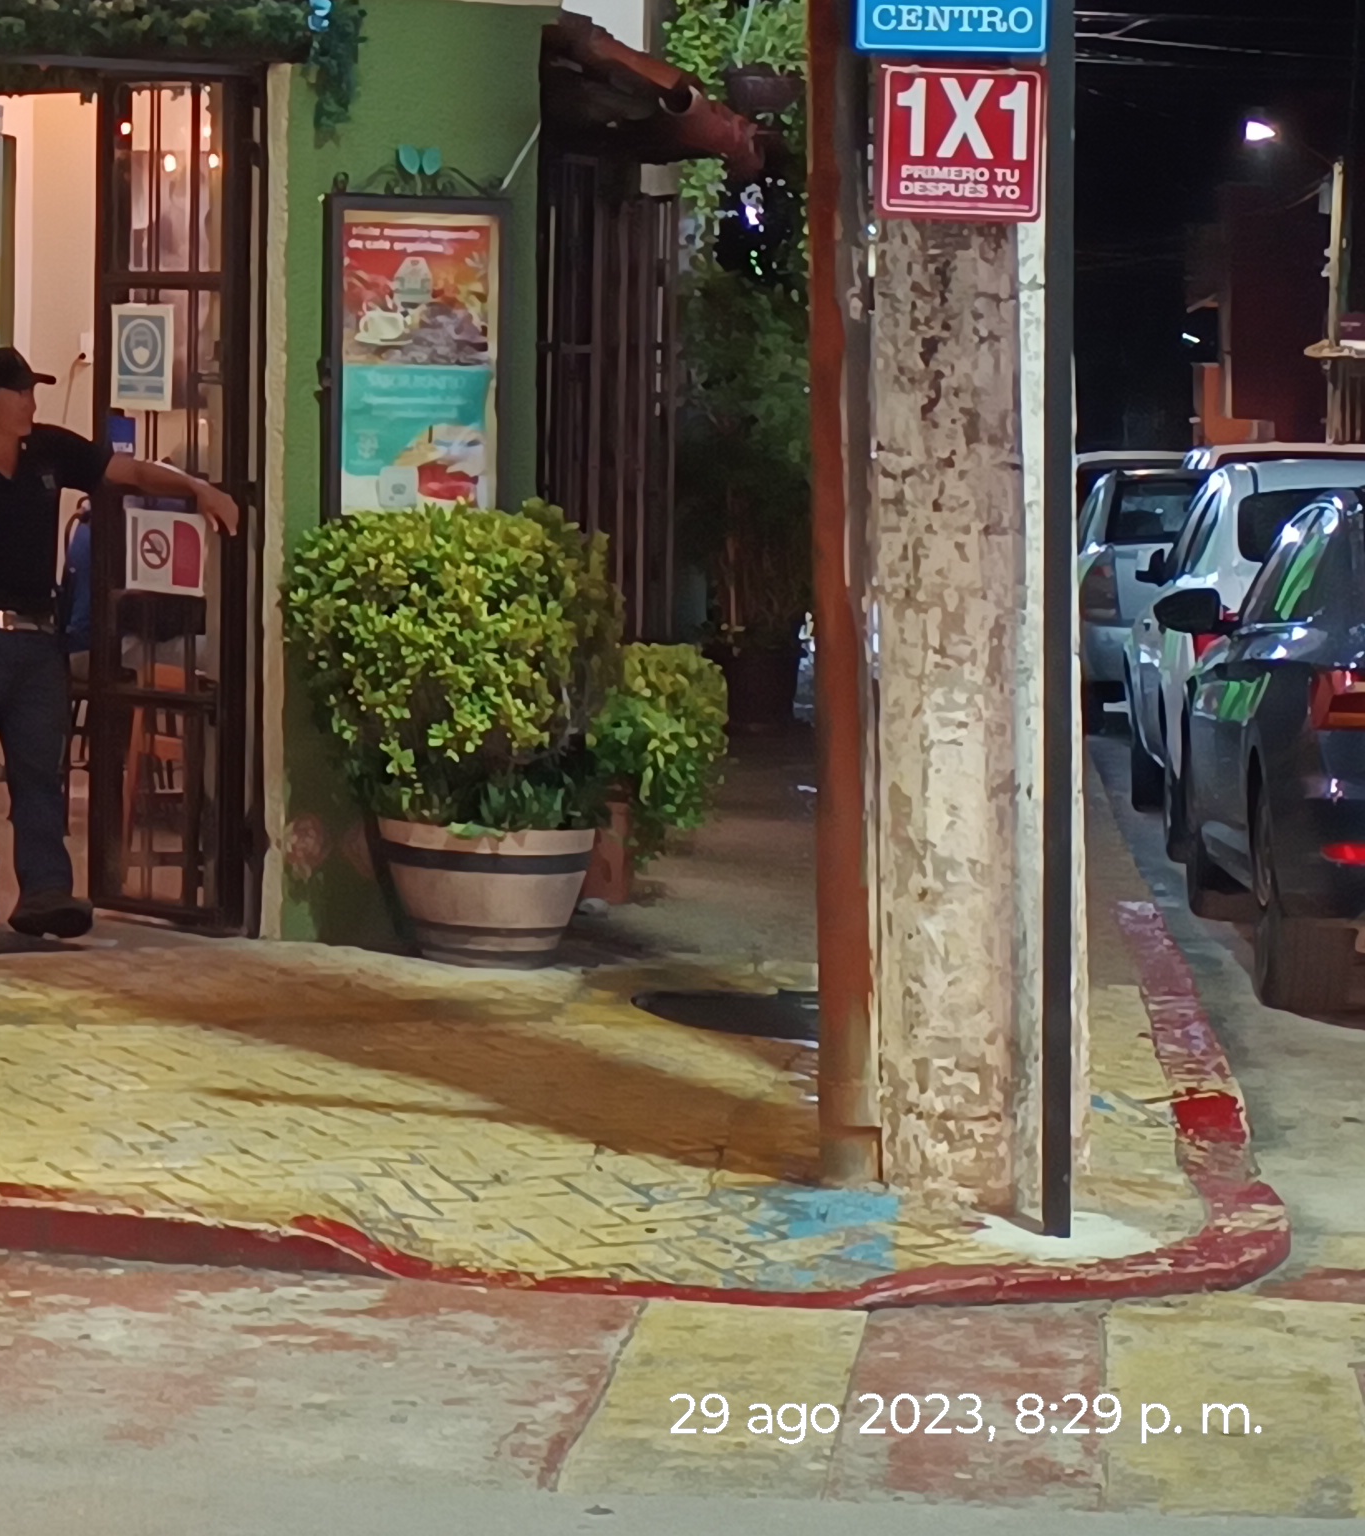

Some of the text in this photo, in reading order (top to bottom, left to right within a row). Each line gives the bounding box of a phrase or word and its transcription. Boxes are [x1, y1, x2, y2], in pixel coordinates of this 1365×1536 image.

[872, 4, 1033, 33] CENTRO
[896, 76, 1030, 161] 1X1
[900, 165, 1020, 183] PRIMERO TU
[993, 184, 1021, 199] YO
